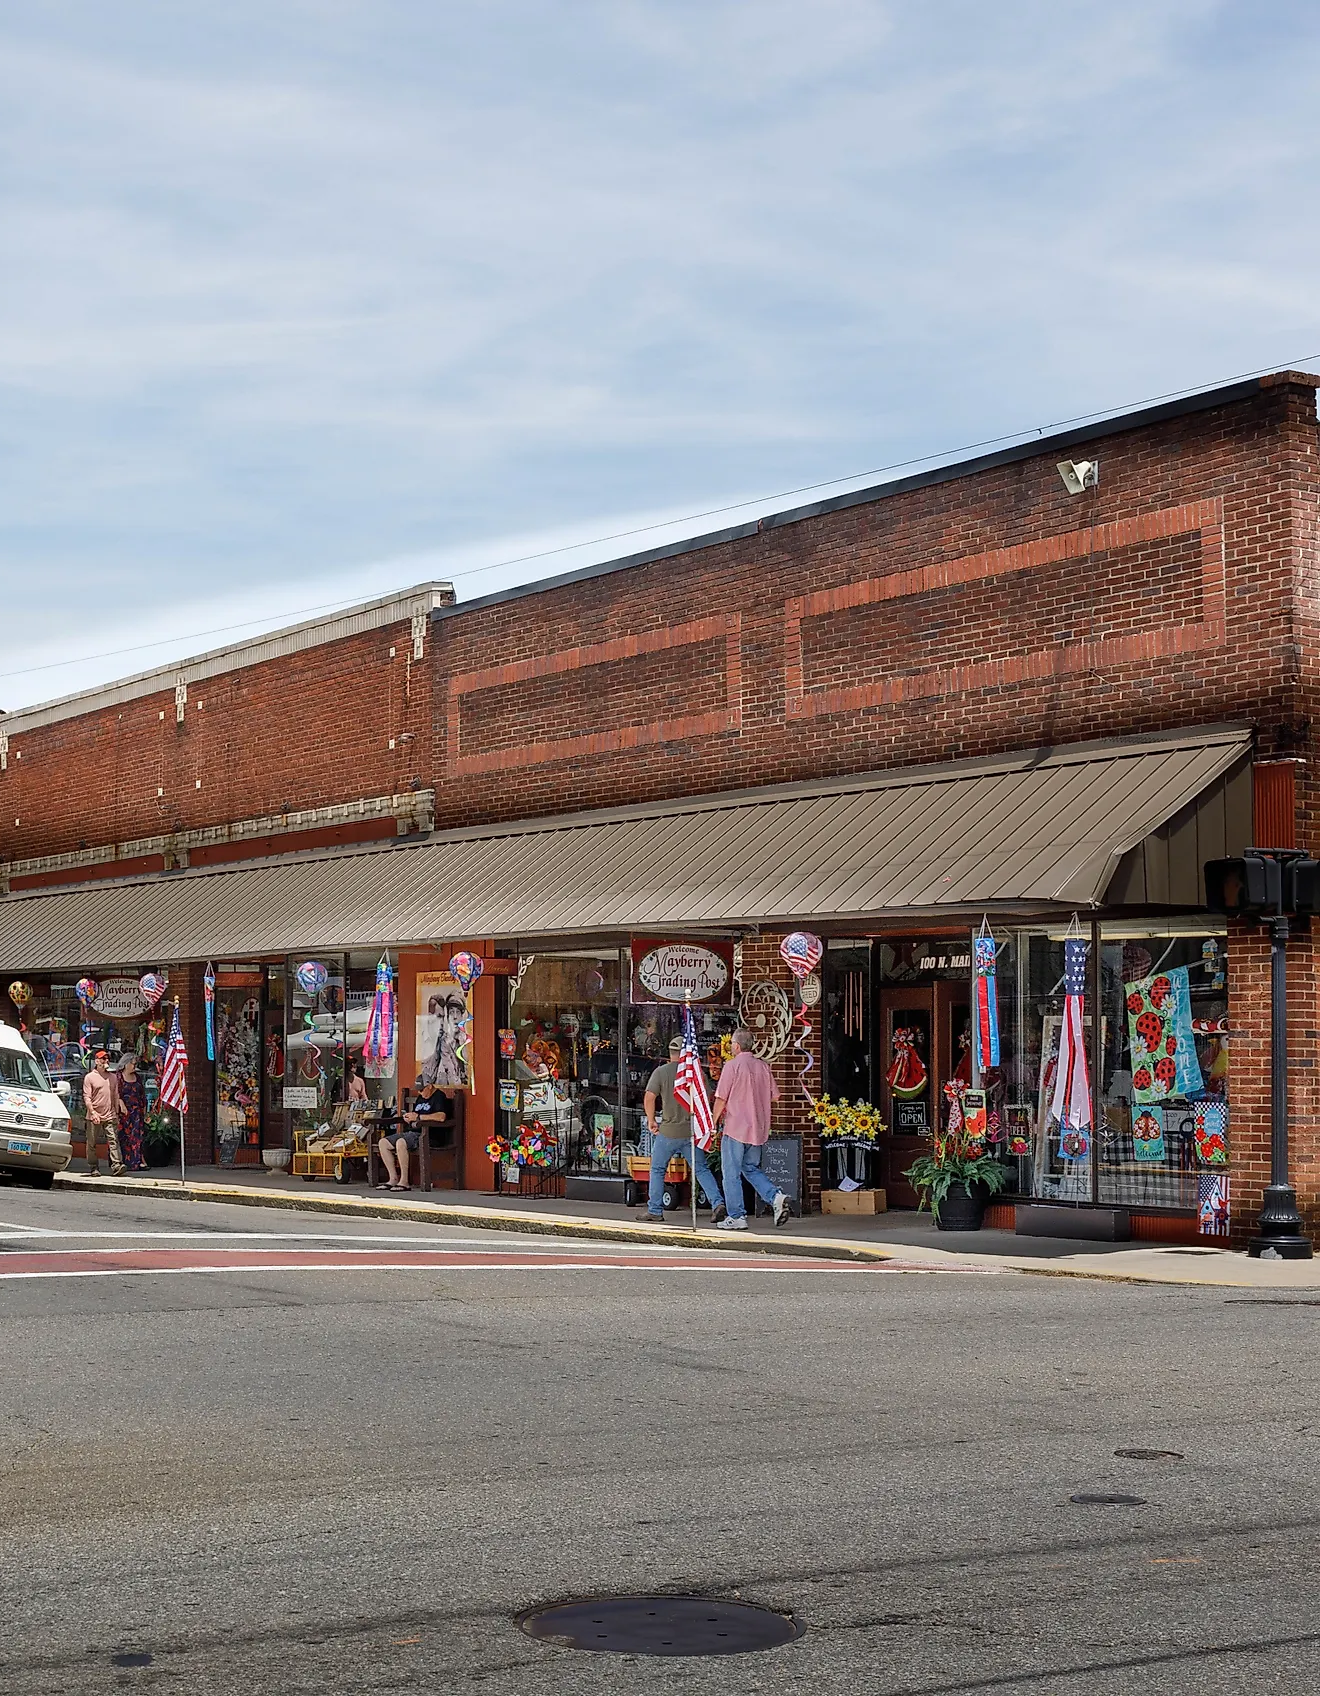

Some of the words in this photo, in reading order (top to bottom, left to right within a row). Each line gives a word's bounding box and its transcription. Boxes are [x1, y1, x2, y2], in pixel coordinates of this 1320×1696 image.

[667, 945, 700, 954] Welcome
[644, 952, 711, 976] Mayberry
[920, 957, 936, 969] 100
[937, 956, 948, 969] N.
[649, 973, 697, 993] Trading
[697, 972, 720, 988] Post
[97, 998, 132, 1011] Trading
[901, 1112, 924, 1124] OPEN
